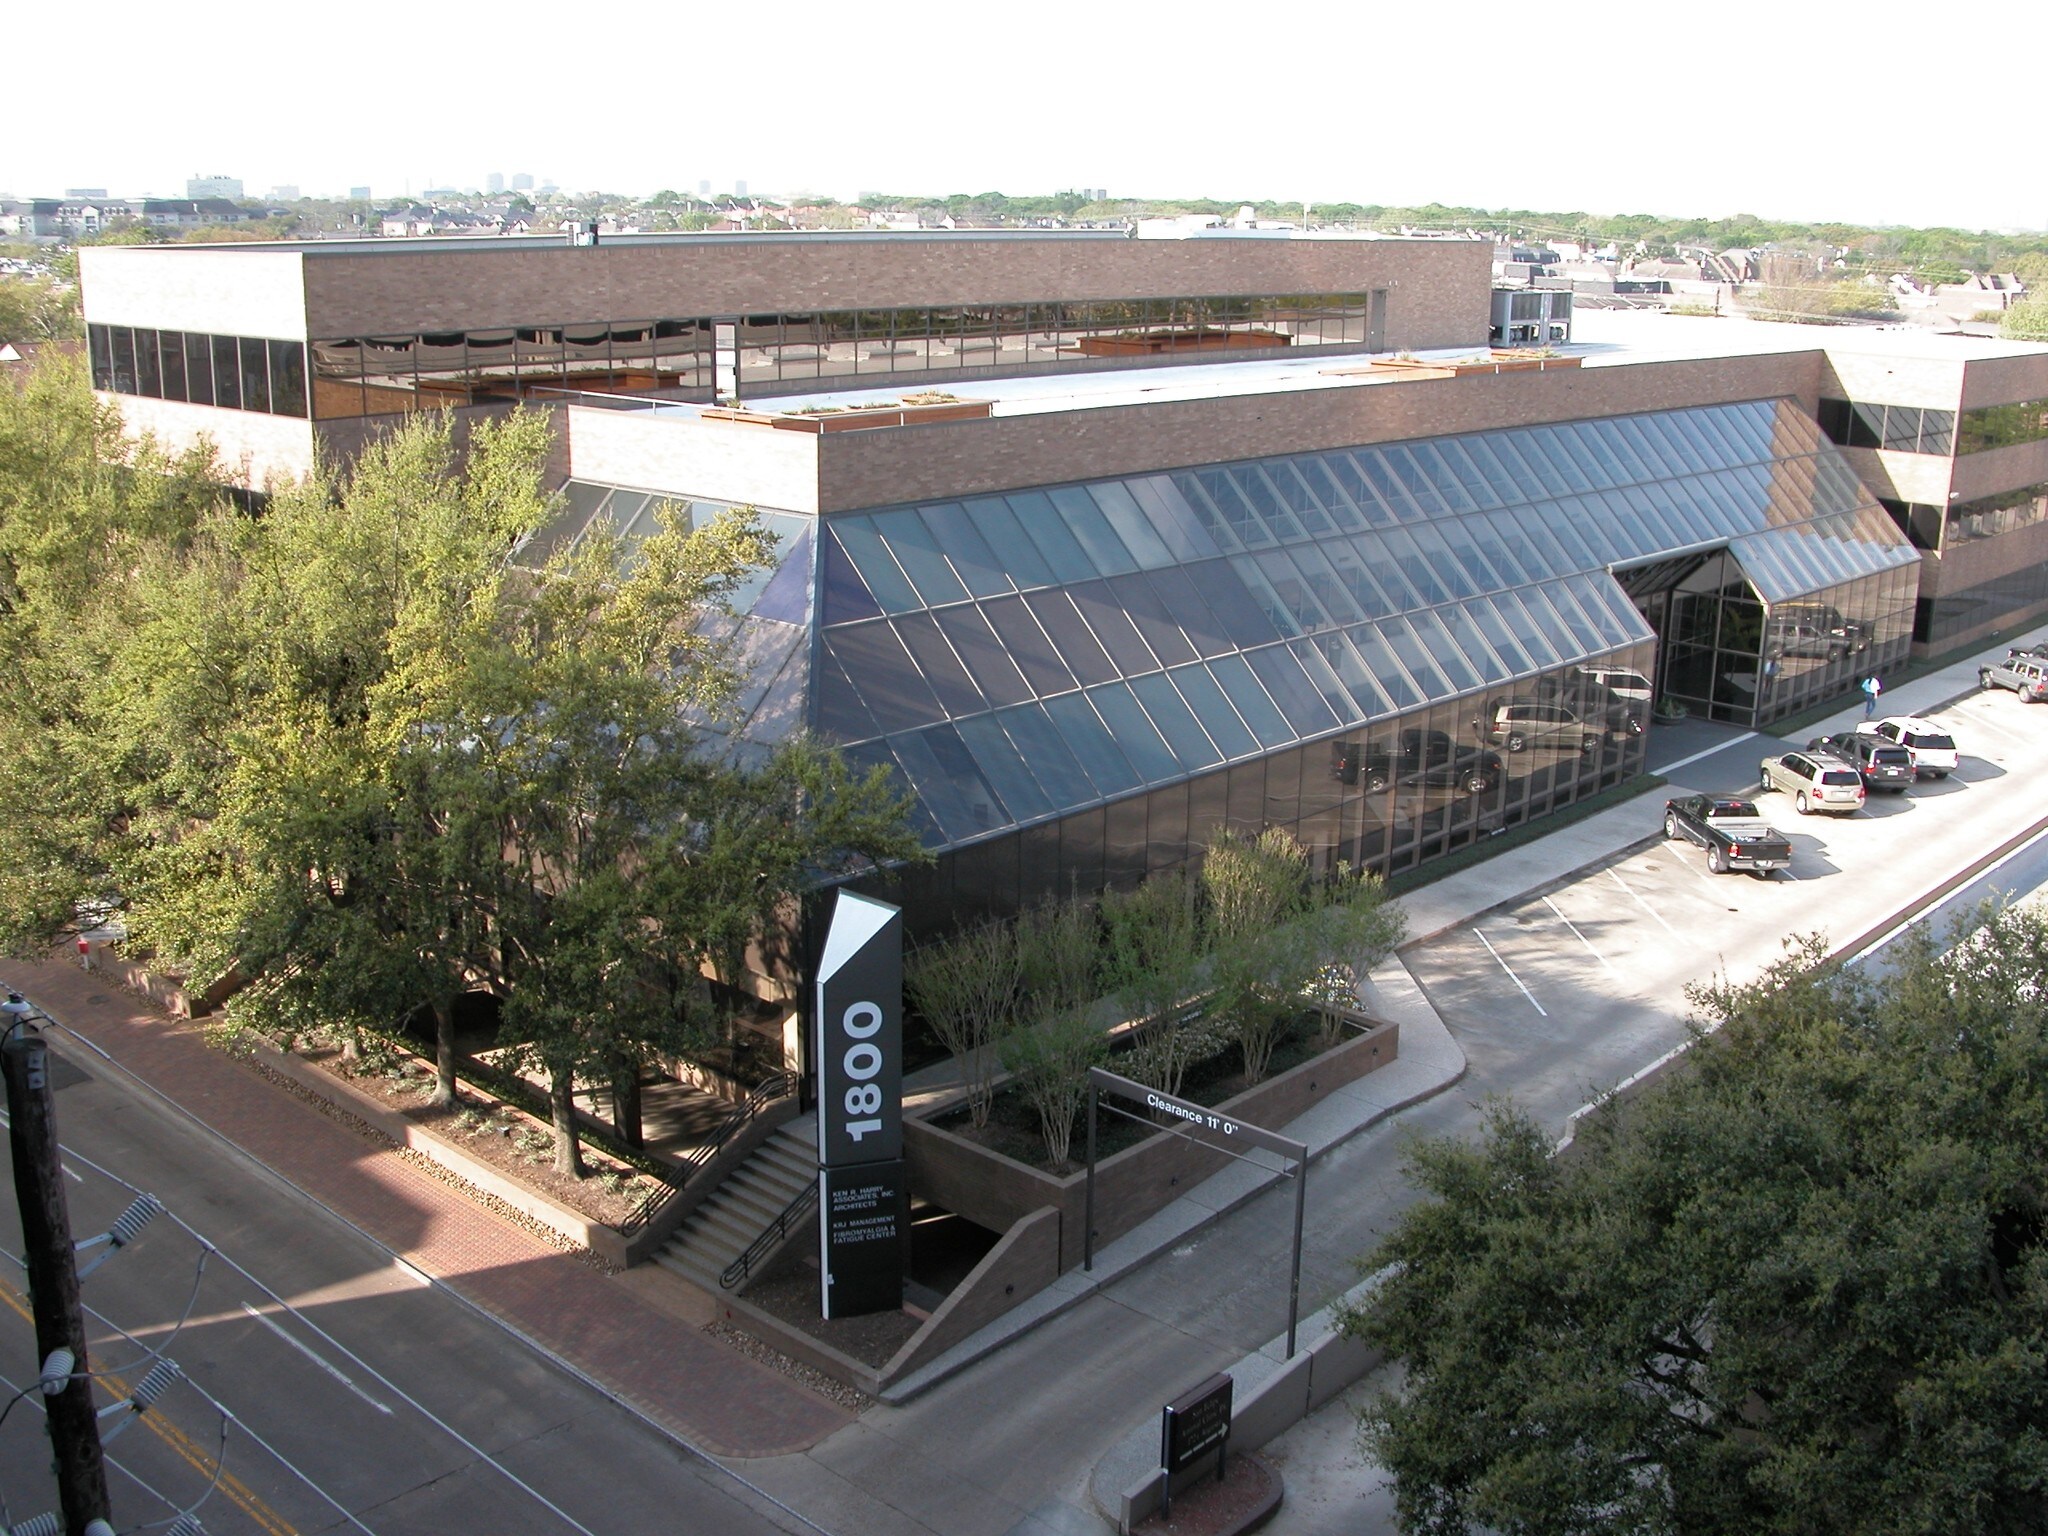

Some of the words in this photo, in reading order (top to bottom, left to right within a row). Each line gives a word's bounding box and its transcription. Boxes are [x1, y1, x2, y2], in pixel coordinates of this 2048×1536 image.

[843, 1001, 883, 1142] 1800
[1147, 1094, 1203, 1123] Clearance
[833, 1190, 848, 1198] KEN
[859, 1186, 884, 1194] HARRY
[833, 1200, 877, 1211] ARCHITECTS
[849, 1215, 895, 1227] MANAGEMENT
[833, 1225, 889, 1238] FIBROMYALGIA
[833, 1234, 865, 1245] FATIGUE
[866, 1231, 896, 1240] CENTER
